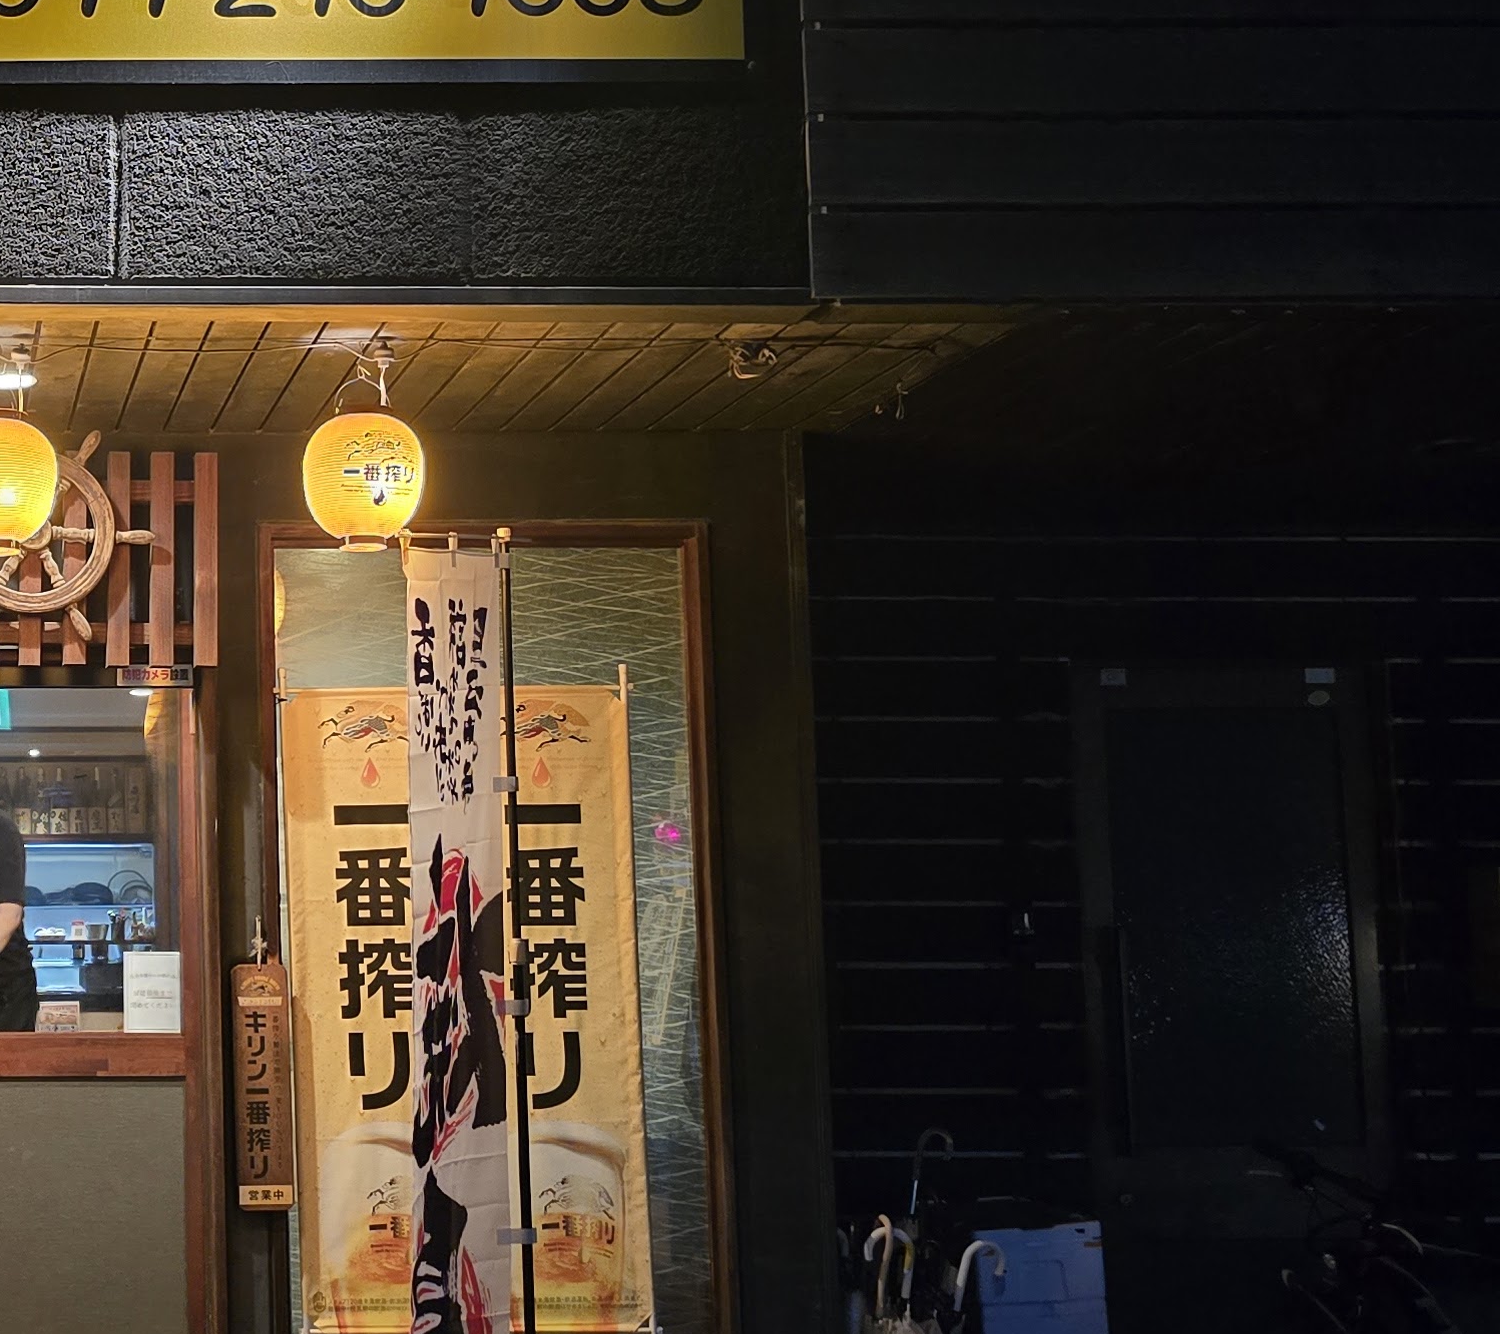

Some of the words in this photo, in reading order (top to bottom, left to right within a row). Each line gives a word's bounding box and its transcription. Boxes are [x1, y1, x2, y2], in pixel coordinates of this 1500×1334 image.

[343, 463, 415, 484] 一番搾り
[121, 668, 189, 681] 防犯カメラ設置
[333, 804, 413, 1110] 一番搾り
[504, 804, 588, 1110] 一番搾り
[244, 1010, 272, 1180] キリン一番搾り
[248, 1189, 285, 1201] 営業中
